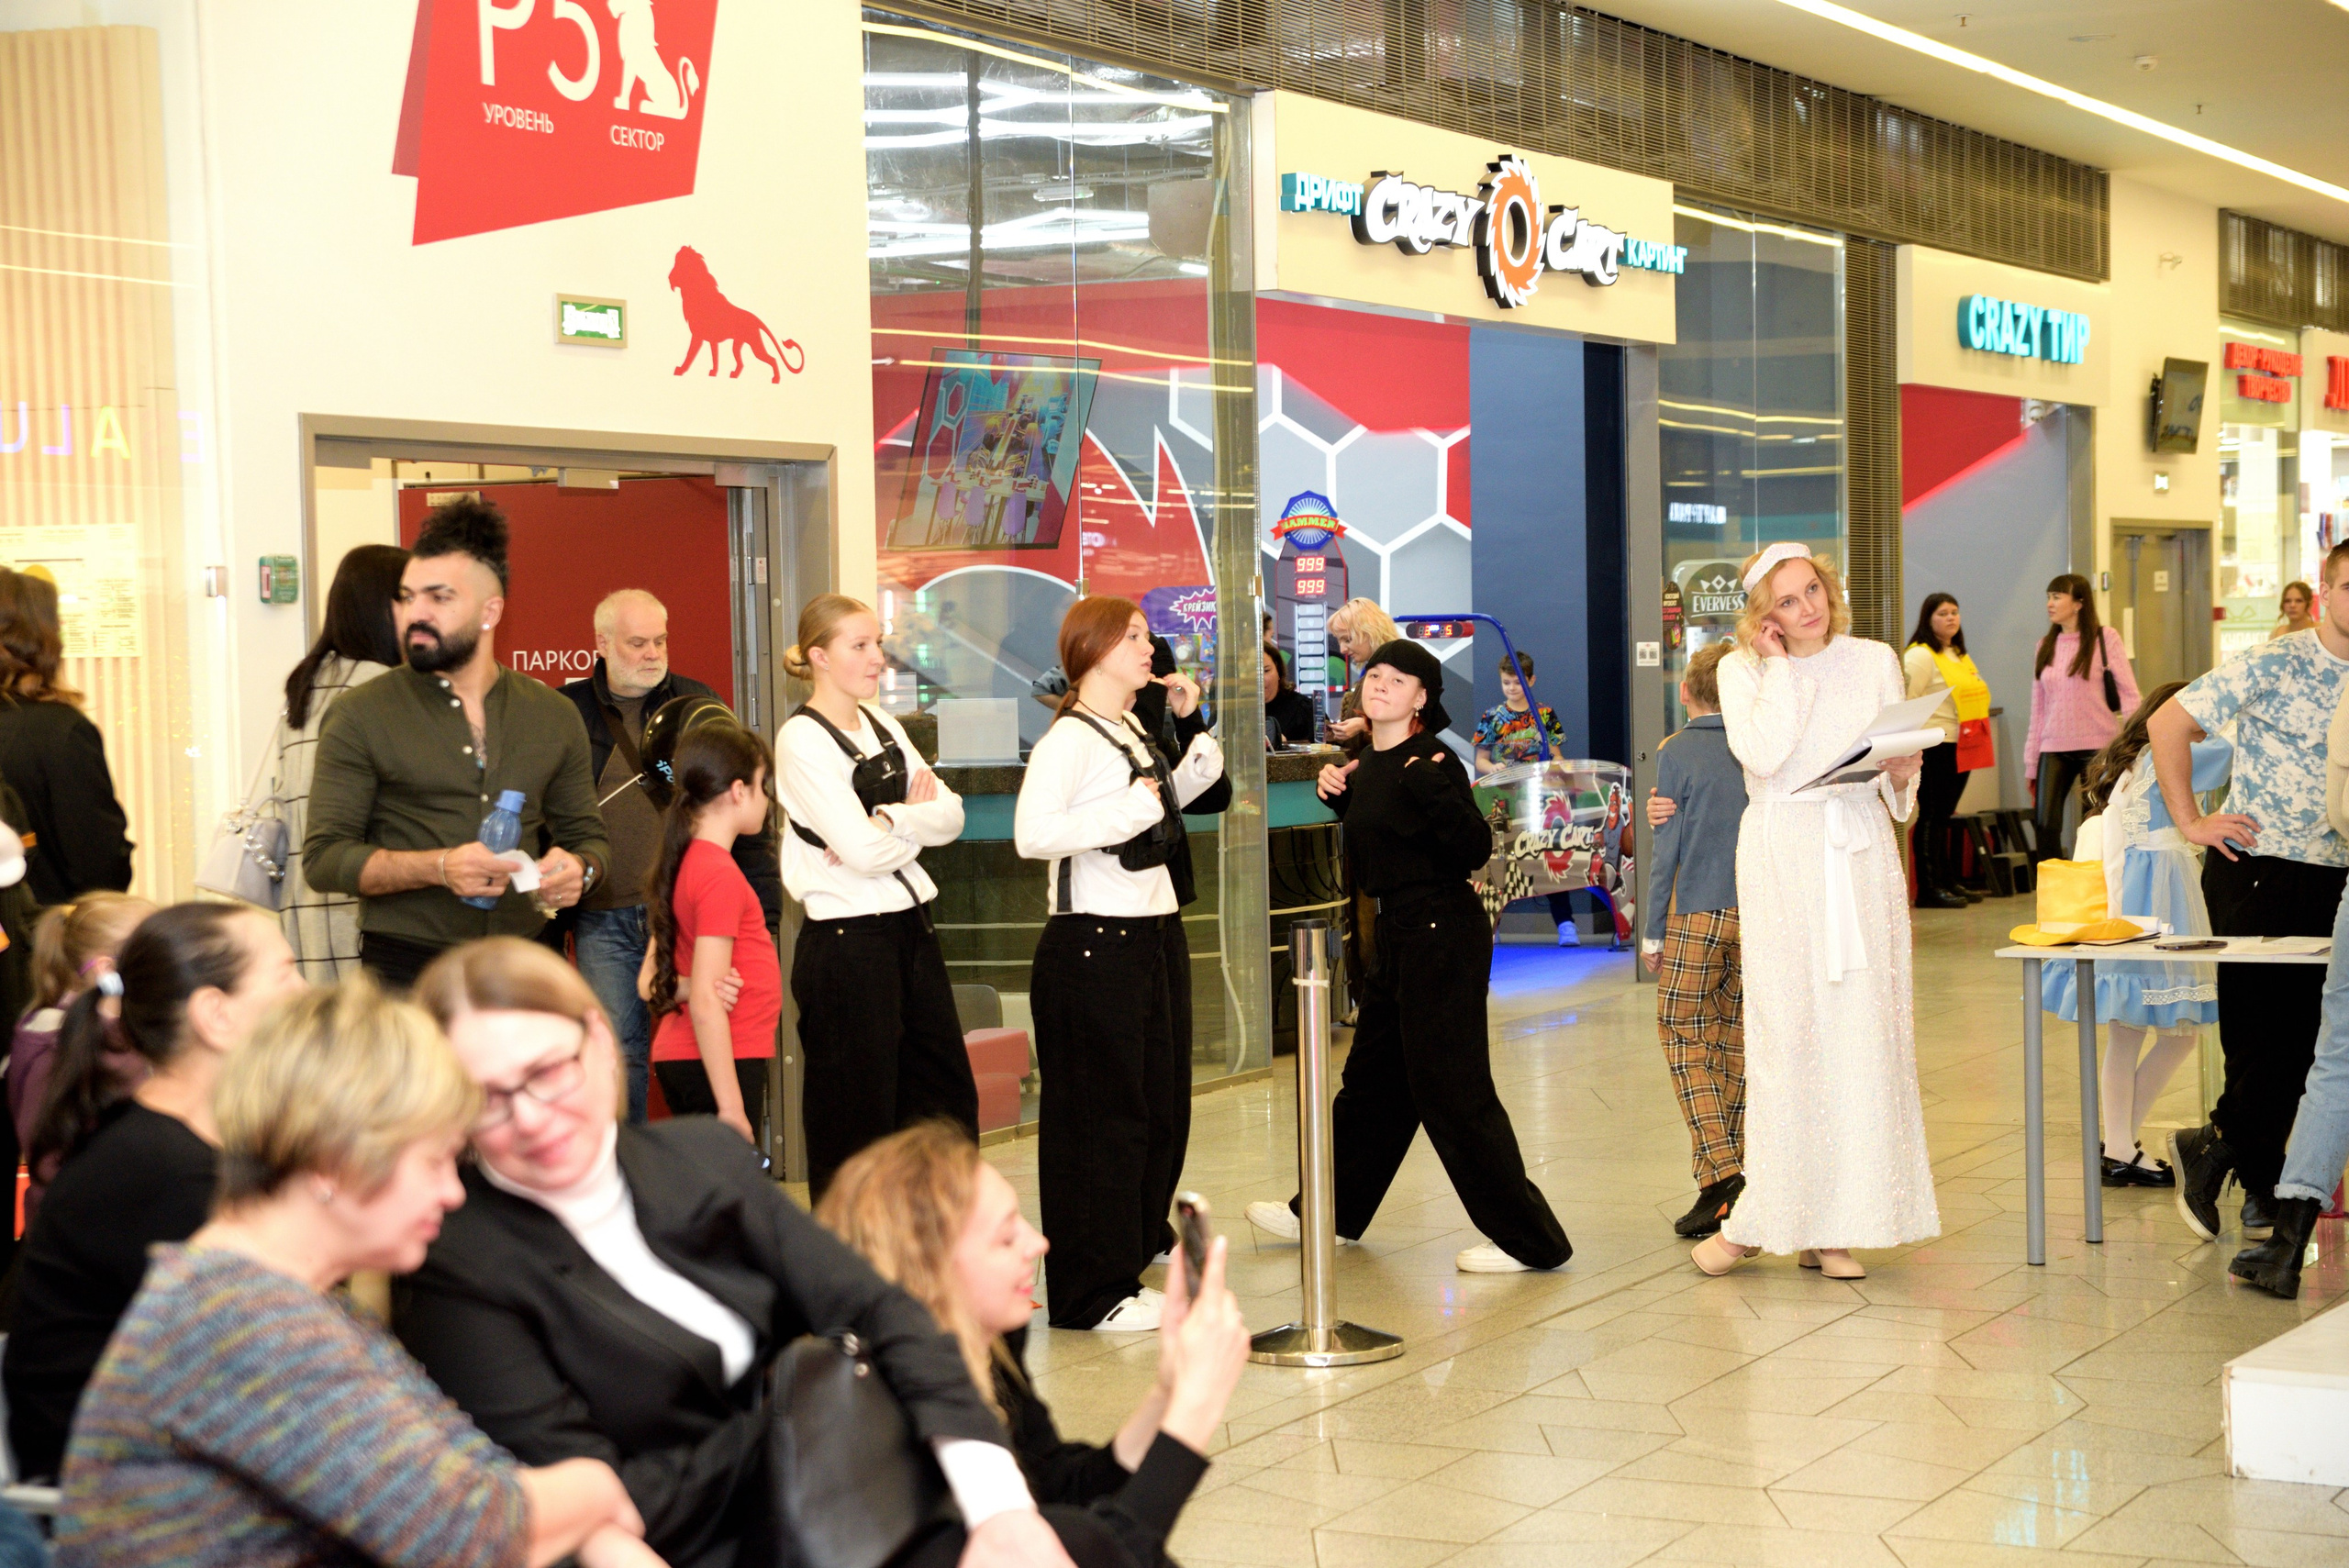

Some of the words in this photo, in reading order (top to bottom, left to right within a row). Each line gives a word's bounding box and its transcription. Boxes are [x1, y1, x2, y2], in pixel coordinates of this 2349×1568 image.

[478, 0, 601, 102] P5
[482, 101, 554, 134] УРОВЕНЬ
[609, 125, 665, 152] СЕКТОР
[1291, 172, 1364, 216] ДРИФТ
[1361, 172, 1486, 255] CRAZY
[1545, 206, 1628, 286] CART
[1626, 237, 1688, 274] КАРТИНГ
[1967, 293, 2044, 358] CRAZY
[2047, 308, 2090, 365] ТИР
[1297, 557, 1325, 573] 999
[1297, 579, 1325, 595] 999
[1692, 594, 1745, 613] EVERVESS
[1515, 828, 1559, 859] CRAZY
